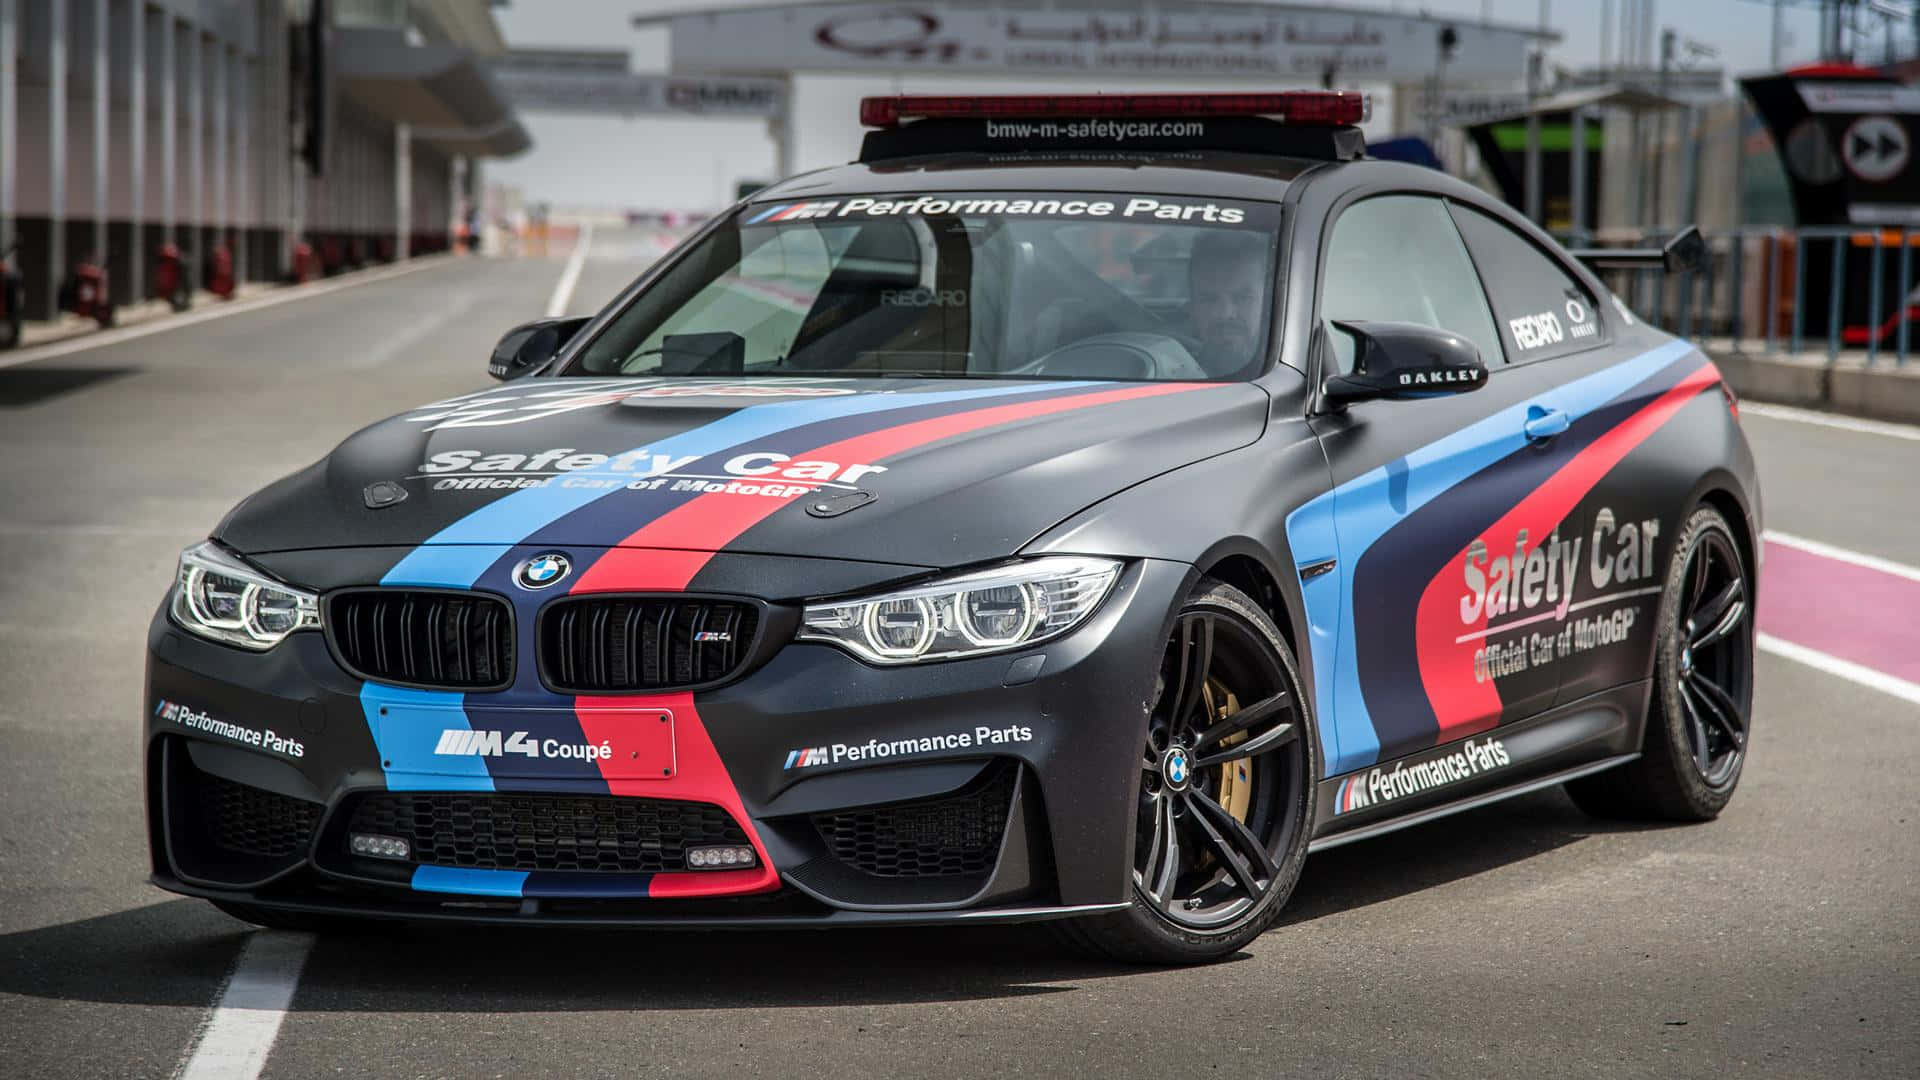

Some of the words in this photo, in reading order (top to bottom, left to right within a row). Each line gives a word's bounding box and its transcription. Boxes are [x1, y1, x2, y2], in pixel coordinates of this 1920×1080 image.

[986, 119, 1204, 141] bmw-m-safetycar.com
[838, 197, 1114, 217] Performance
[1123, 199, 1245, 223] Parts
[880, 289, 967, 307] RECARO
[1509, 311, 1563, 351] RECARO
[1400, 369, 1479, 385] OAKLEY
[418, 448, 703, 478] Safety
[723, 452, 888, 484] Car
[433, 477, 550, 491] Official
[560, 478, 622, 489] Car
[626, 479, 669, 490] of
[1460, 522, 1582, 625] Safety
[1591, 507, 1659, 588] Car
[1474, 637, 1527, 683] Official
[1530, 632, 1554, 667] Car
[1557, 622, 1572, 656] of
[178, 706, 261, 745] Performance
[263, 720, 304, 757] Parts
[832, 732, 972, 763] Performance
[975, 725, 1033, 745] Parts
[543, 740, 612, 762] Coupé
[1369, 752, 1469, 803] Performance
[1465, 740, 1511, 773] Parts
